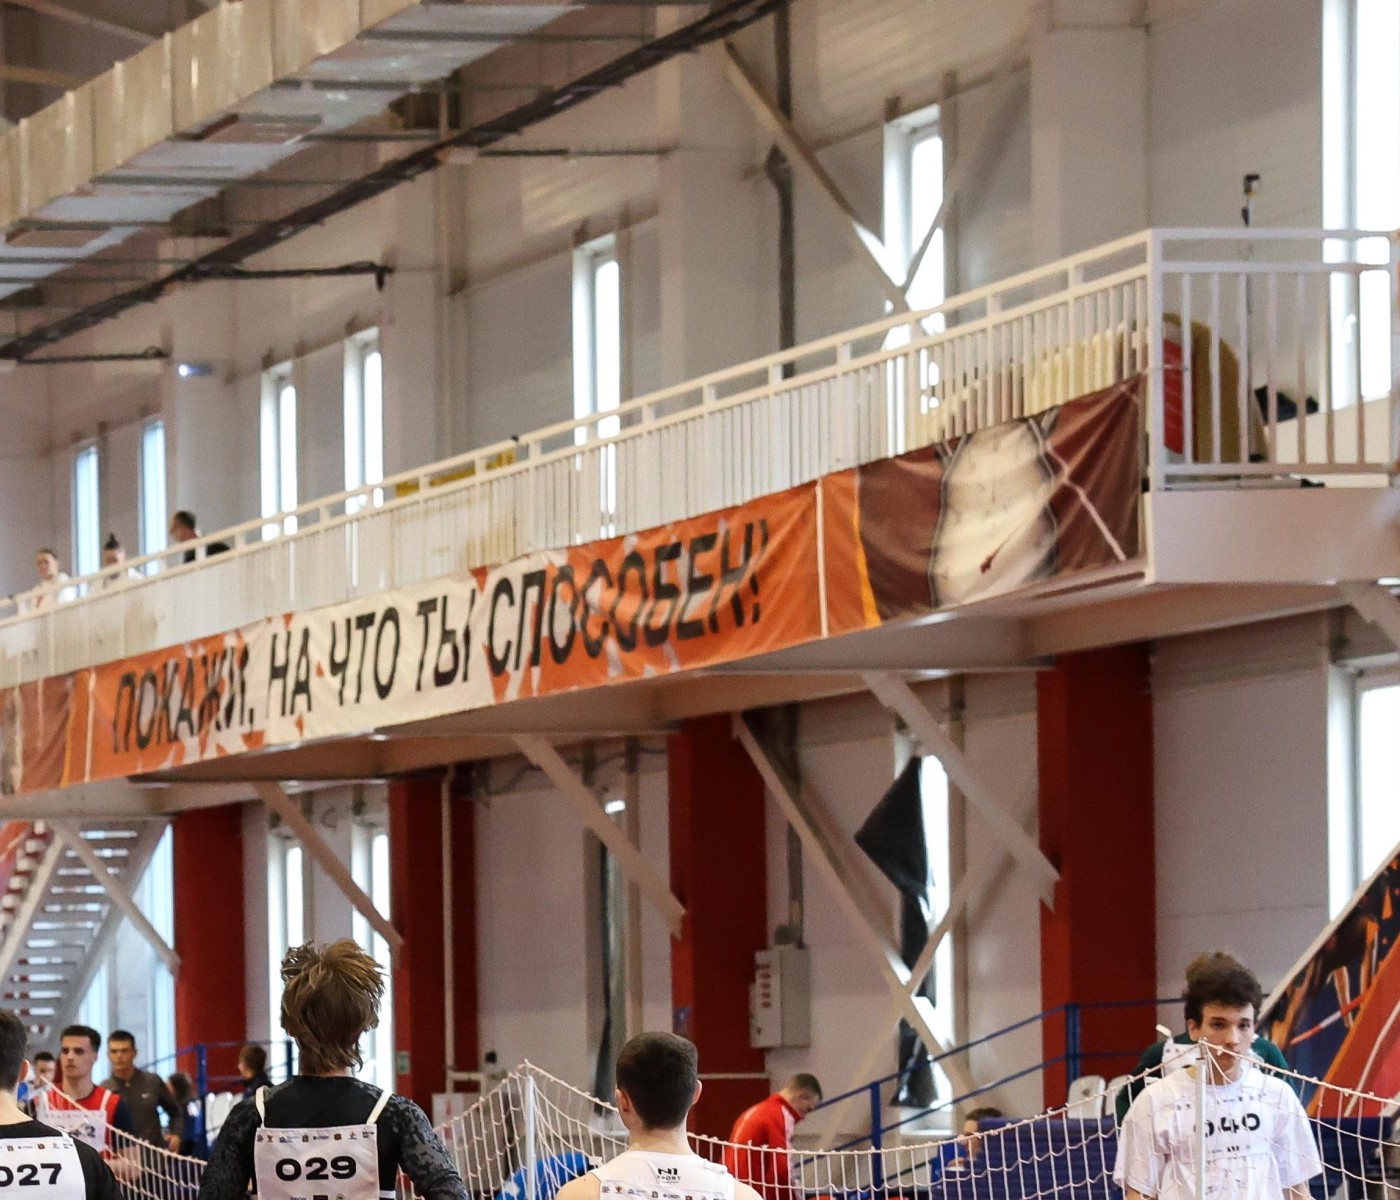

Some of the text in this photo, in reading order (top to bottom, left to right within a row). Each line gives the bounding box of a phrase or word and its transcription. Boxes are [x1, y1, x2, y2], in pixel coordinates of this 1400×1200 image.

[268, 627, 312, 718] НА
[330, 607, 400, 706] ЧТО
[416, 588, 476, 692] ТЫ
[488, 519, 770, 678] СПОСОБЕН!
[275, 1156, 357, 1181] 029
